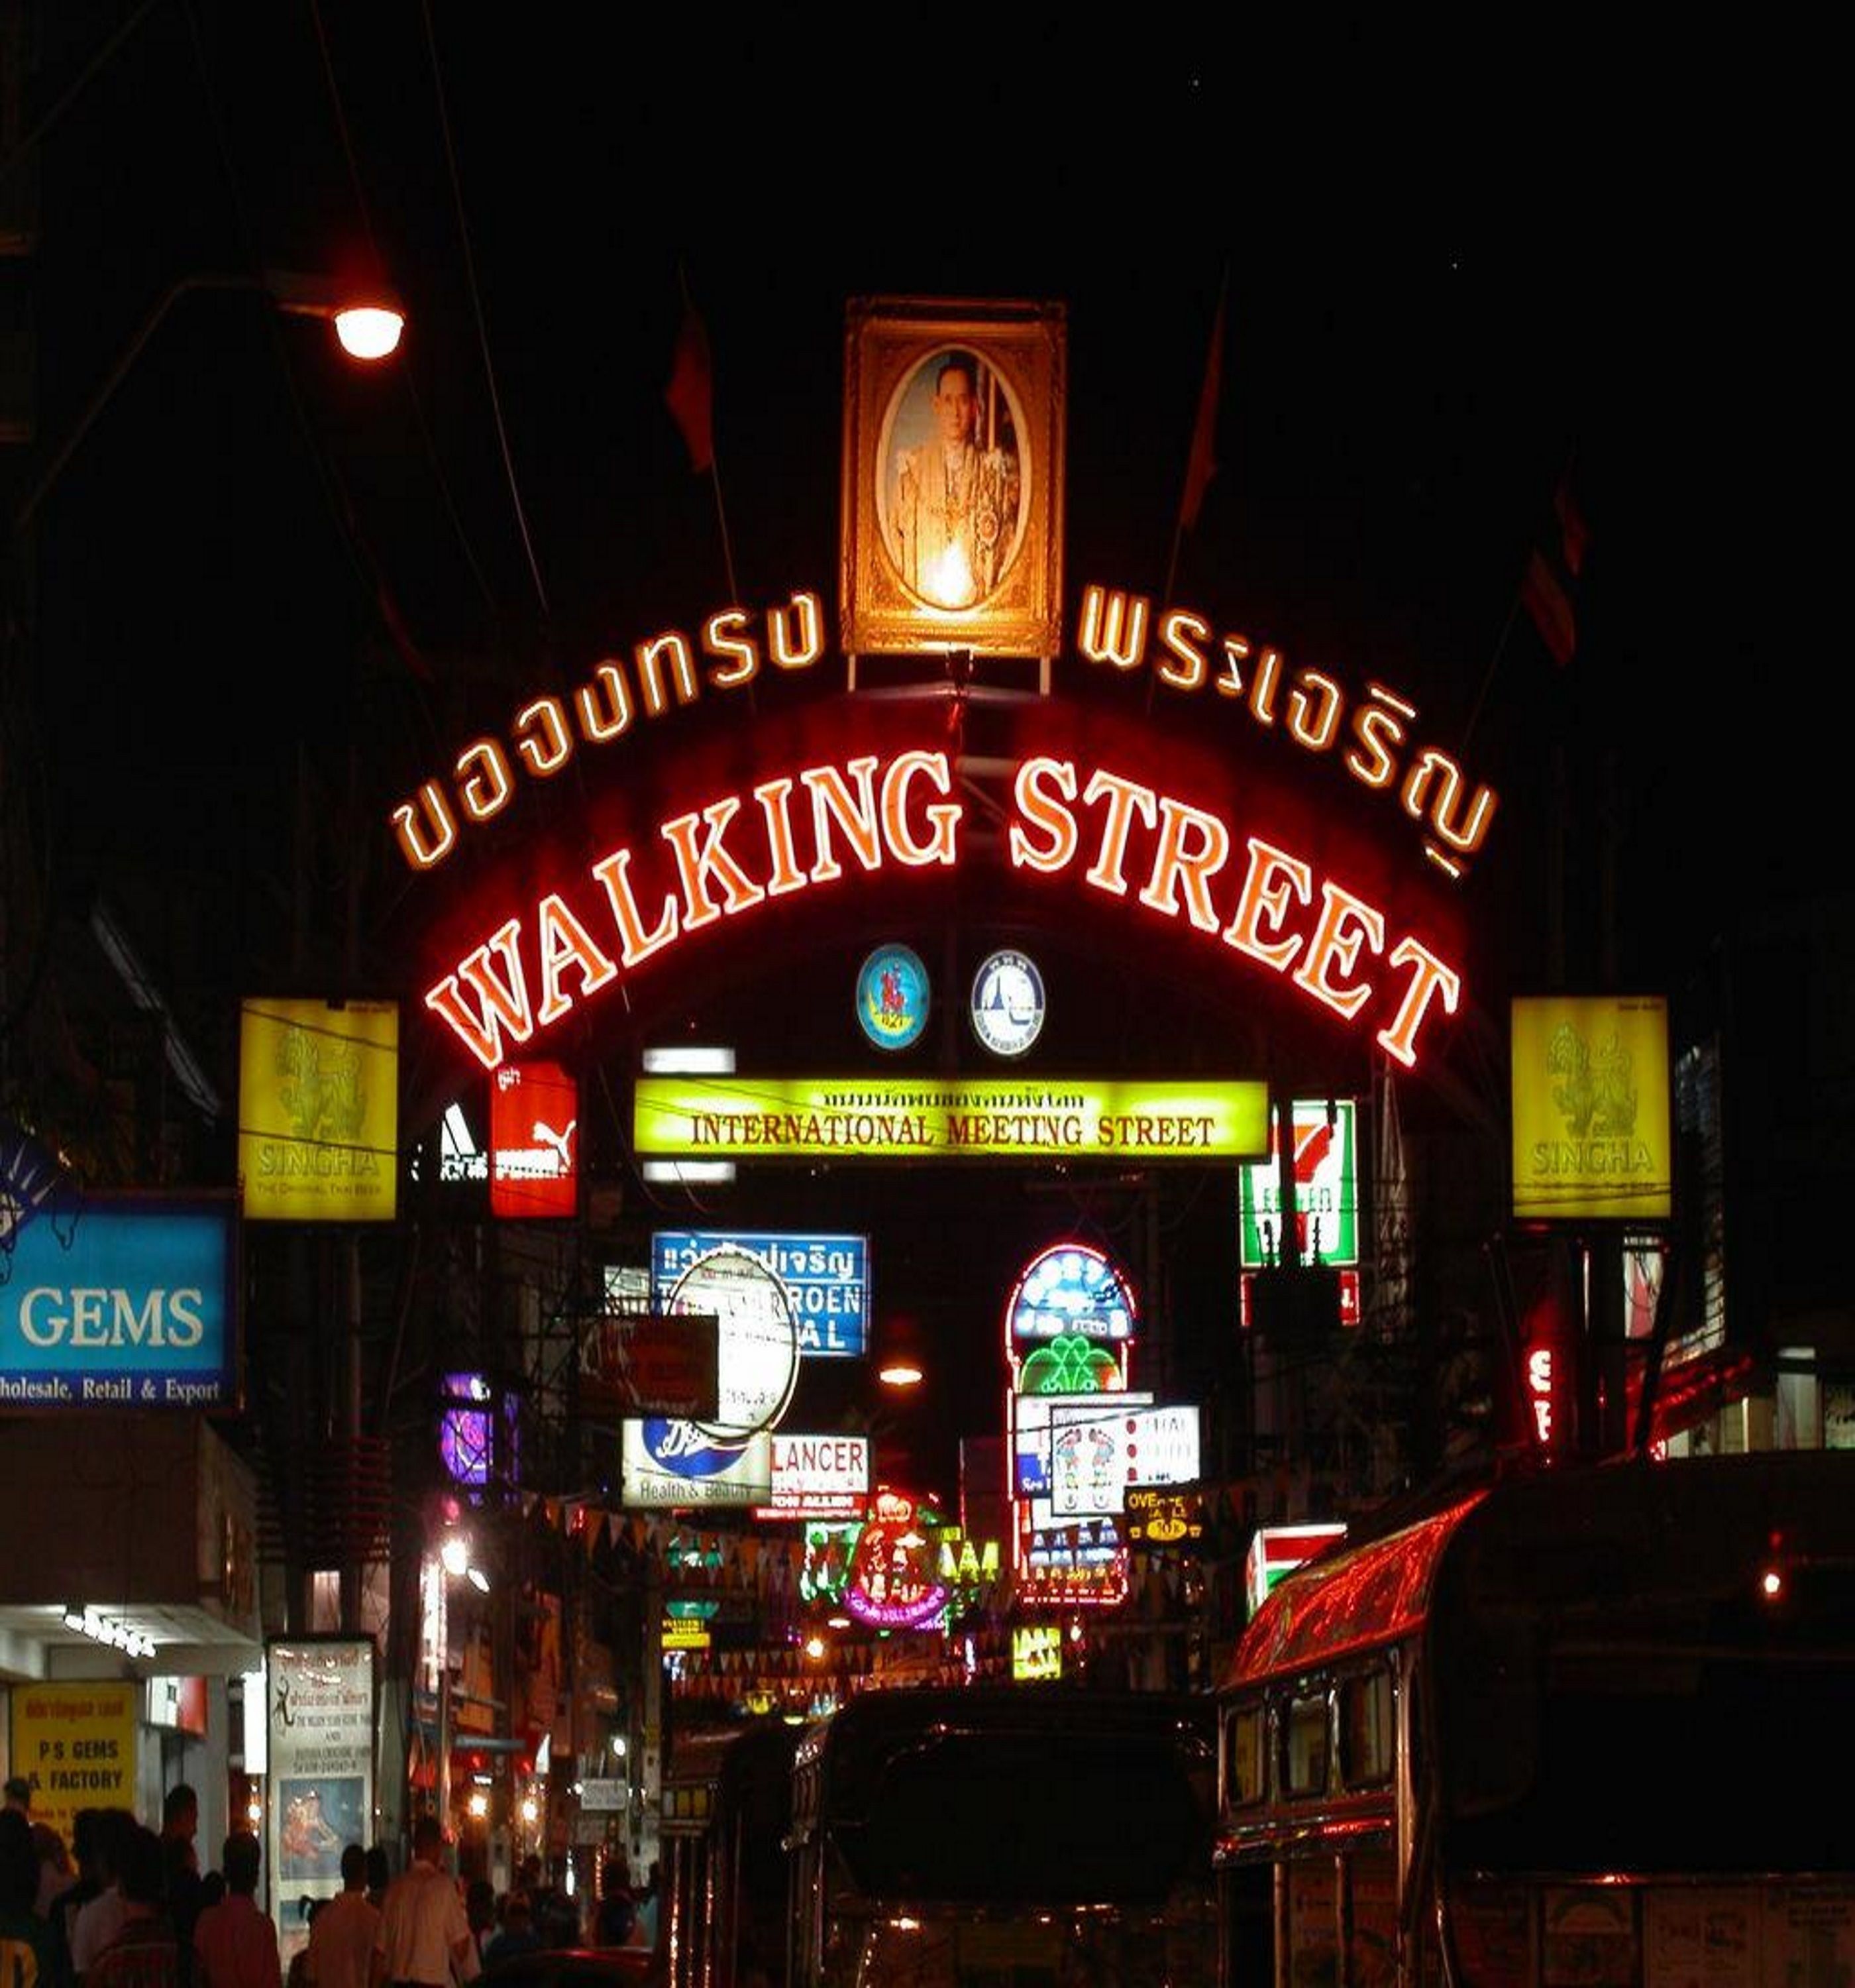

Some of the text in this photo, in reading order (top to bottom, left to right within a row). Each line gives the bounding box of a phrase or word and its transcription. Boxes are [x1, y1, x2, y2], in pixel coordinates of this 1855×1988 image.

[1080, 586, 1496, 877] พระเจริญ
[425, 751, 1460, 1069] WALKING STREET
[692, 1114, 1215, 1146] INTERNATIONAL MEETING STREET
[258, 1142, 380, 1178] SINGHA
[1532, 1139, 1655, 1176] SINGHA
[19, 1288, 203, 1347] GEMS
[0, 1376, 219, 1405] holesale, Retail & Export
[770, 1441, 863, 1472] LANCER
[640, 1480, 685, 1501] Health
[40, 1739, 119, 1761] P S GEMS
[50, 1769, 123, 1790] FACTORY
